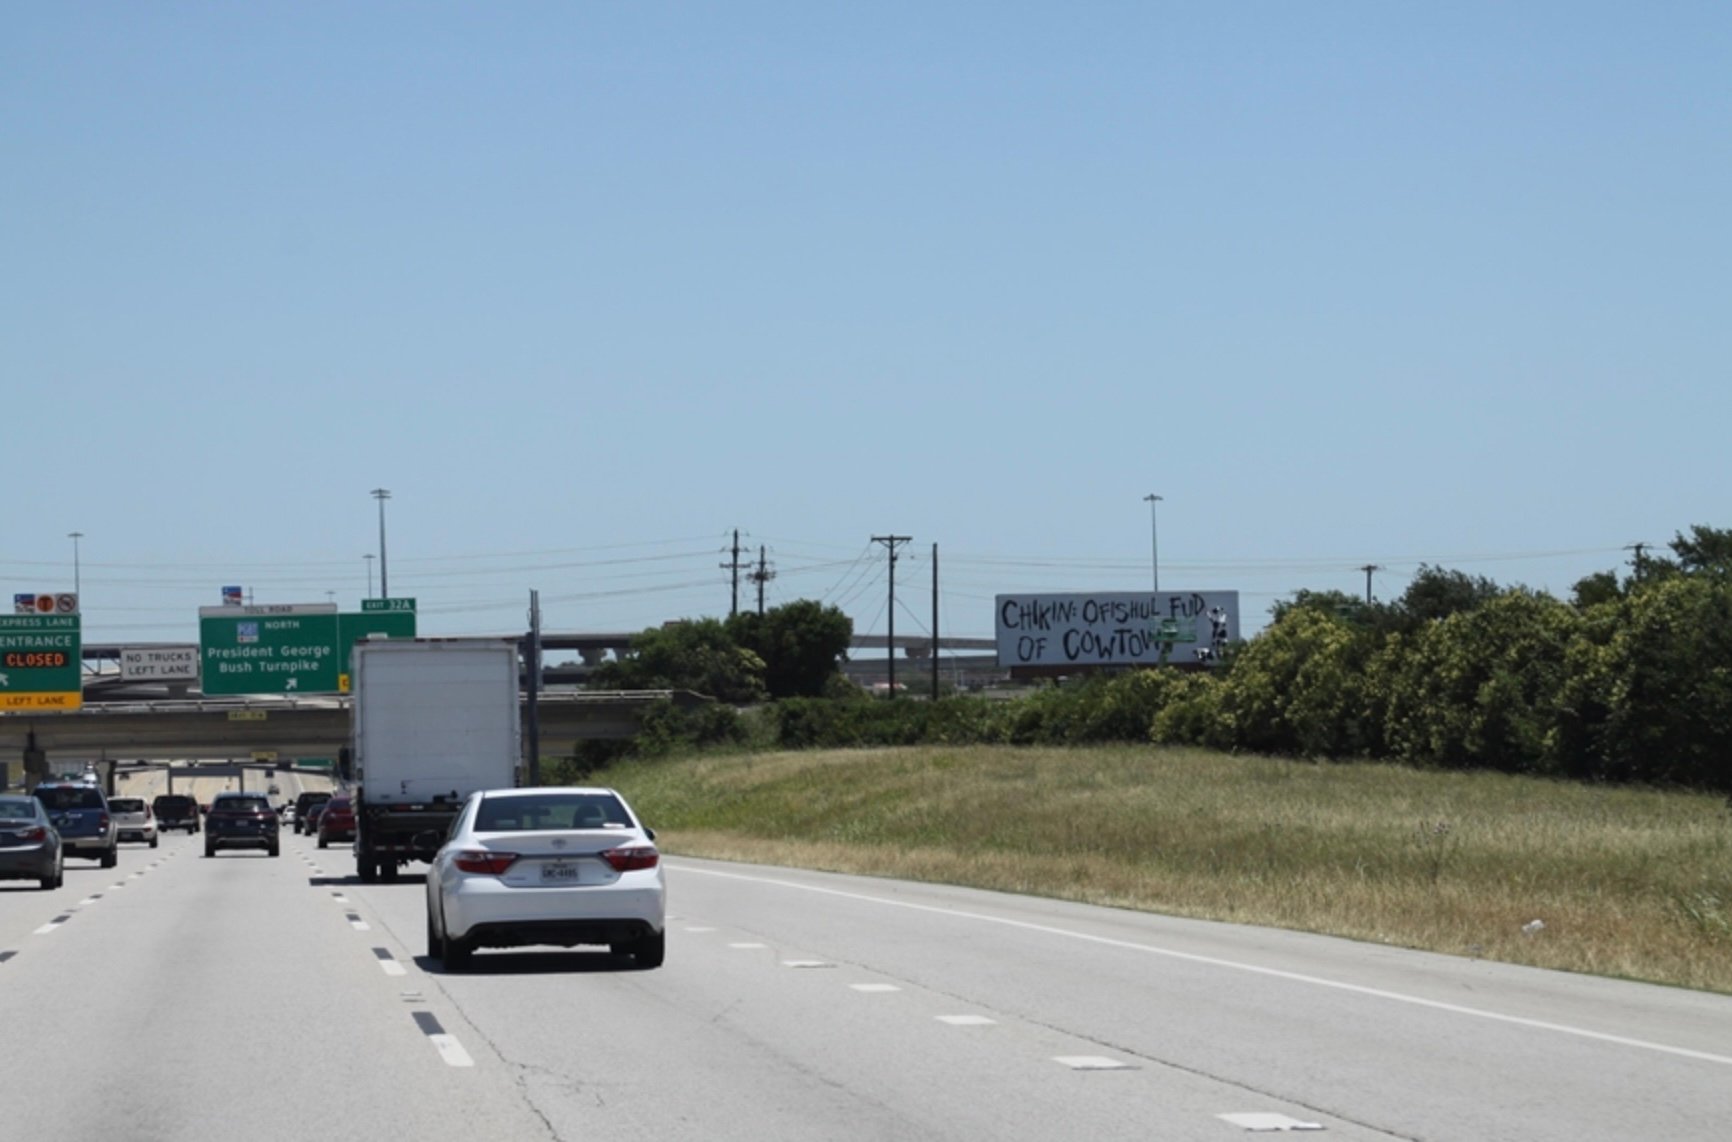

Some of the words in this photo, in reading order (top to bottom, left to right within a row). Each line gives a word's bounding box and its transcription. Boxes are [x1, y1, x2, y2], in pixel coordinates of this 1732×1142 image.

[244, 606, 267, 614] TOLL
[269, 605, 293, 613] ROAD
[388, 599, 411, 610] 32A
[1001, 598, 1077, 631] CHIKIN:
[1082, 598, 1161, 626] OFISHUL
[1169, 593, 1206, 620] FUD
[46, 618, 74, 626] LANE
[264, 620, 300, 630] NORTH
[0, 635, 72, 647] ENTRANCE
[207, 646, 273, 658] President
[281, 645, 331, 659] George
[1017, 635, 1047, 662] OF
[6, 653, 65, 667] CLOSED
[126, 653, 142, 663] NO
[148, 652, 192, 662] TRUCKS
[128, 666, 154, 675] LEFT
[161, 665, 190, 674] LANE
[219, 661, 252, 673] Bush
[259, 660, 320, 674] Turnpike
[6, 696, 33, 705] LEFT
[37, 695, 66, 705] LANE
